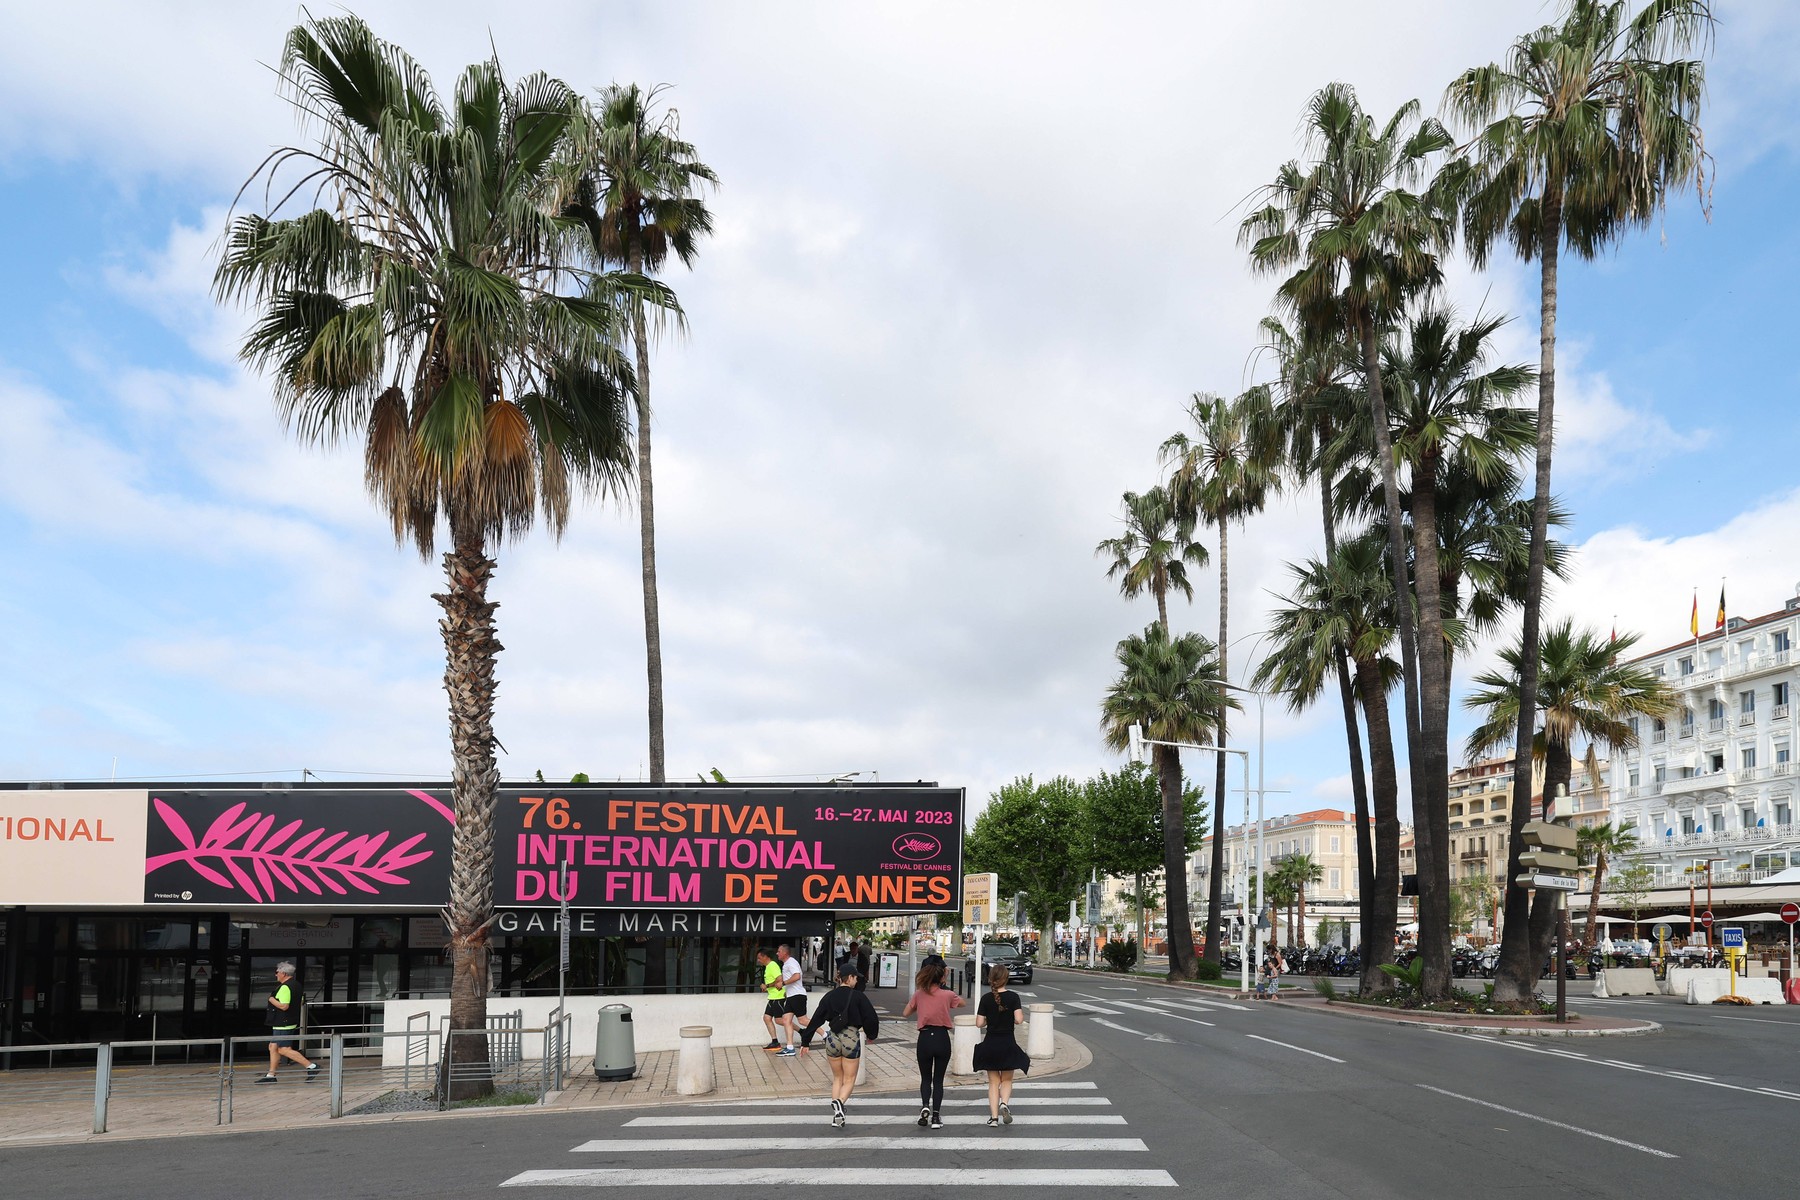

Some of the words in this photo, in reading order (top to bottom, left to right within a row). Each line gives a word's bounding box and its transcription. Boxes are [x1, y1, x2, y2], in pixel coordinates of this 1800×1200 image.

[519, 797, 582, 830] 76.
[608, 800, 798, 835] FESTIVAL
[878, 809, 909, 823] MAI
[915, 810, 953, 825] 2023
[517, 833, 836, 870] INTERNATIONAL
[880, 863, 912, 871] FESTIVAL
[516, 870, 579, 902] DU
[606, 871, 701, 902] FILM
[725, 873, 779, 903] DE
[802, 874, 952, 905] CANNES
[619, 912, 787, 932] MARITIME
[270, 929, 334, 938] REGISTRATION
[1725, 933, 1742, 942] TAXIS
